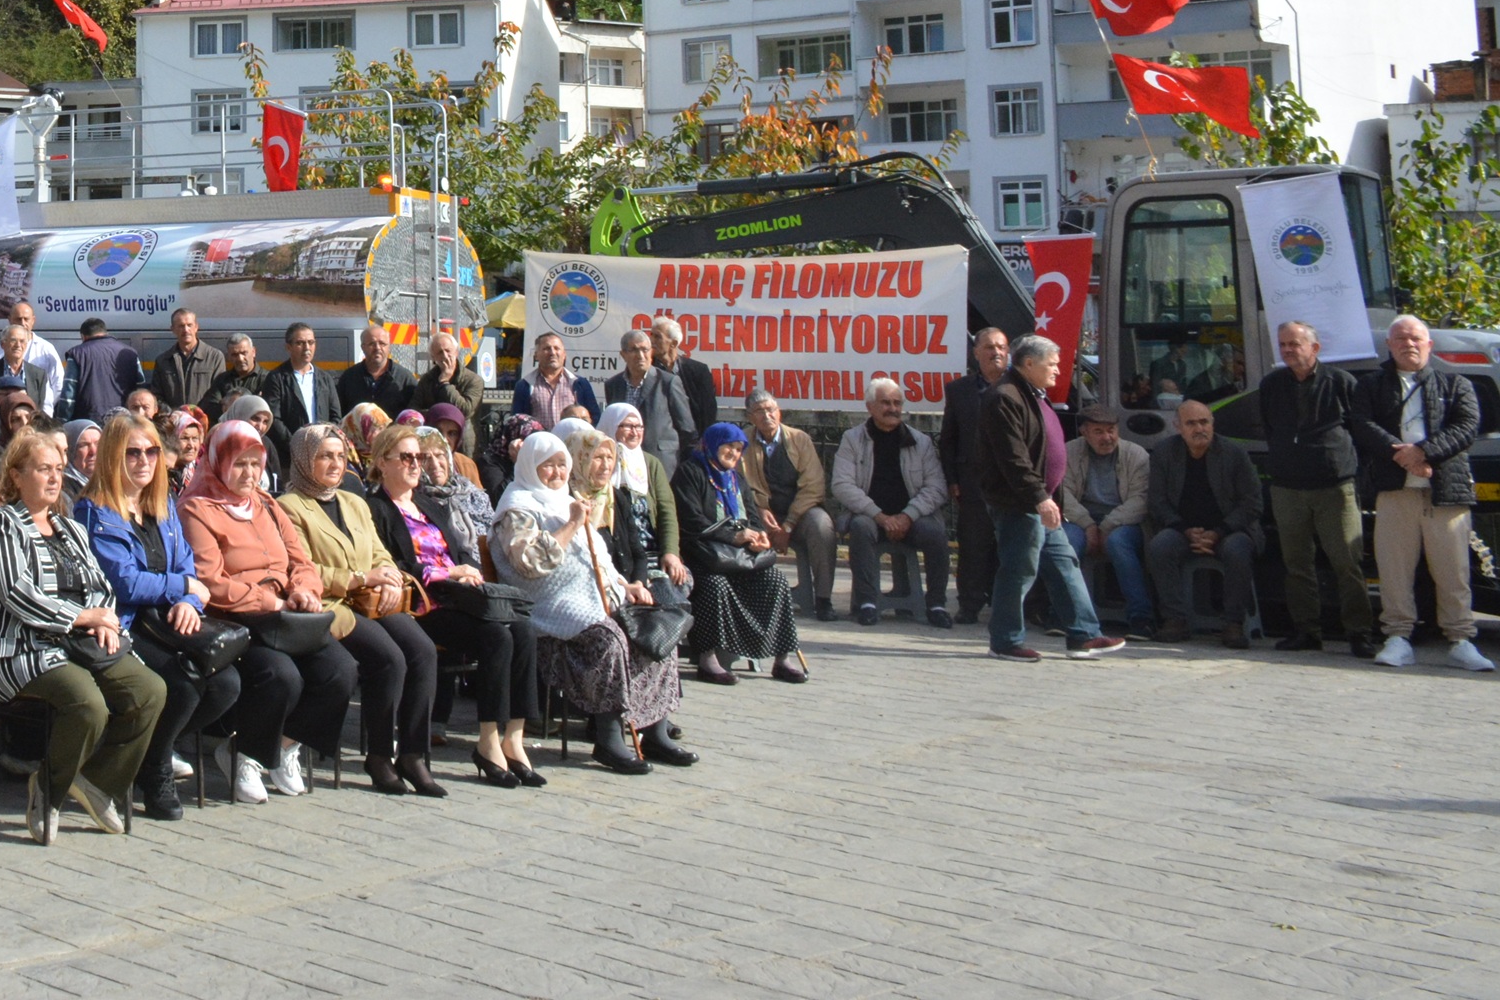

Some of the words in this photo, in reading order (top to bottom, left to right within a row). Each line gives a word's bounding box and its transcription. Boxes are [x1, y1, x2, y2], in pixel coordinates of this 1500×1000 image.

[715, 214, 803, 240] ZOOMLION
[1294, 265, 1320, 275] 1998
[95, 278, 116, 286] 1998
[541, 264, 568, 310] DUROĞLU
[571, 263, 607, 312] BELEDİYESİ
[653, 264, 746, 306] ARAÇ
[752, 260, 924, 299] FİLOMUZU
[564, 326, 585, 334] 1998
[571, 354, 618, 372] ÇETİN
[763, 369, 865, 401] HAYIRLI
